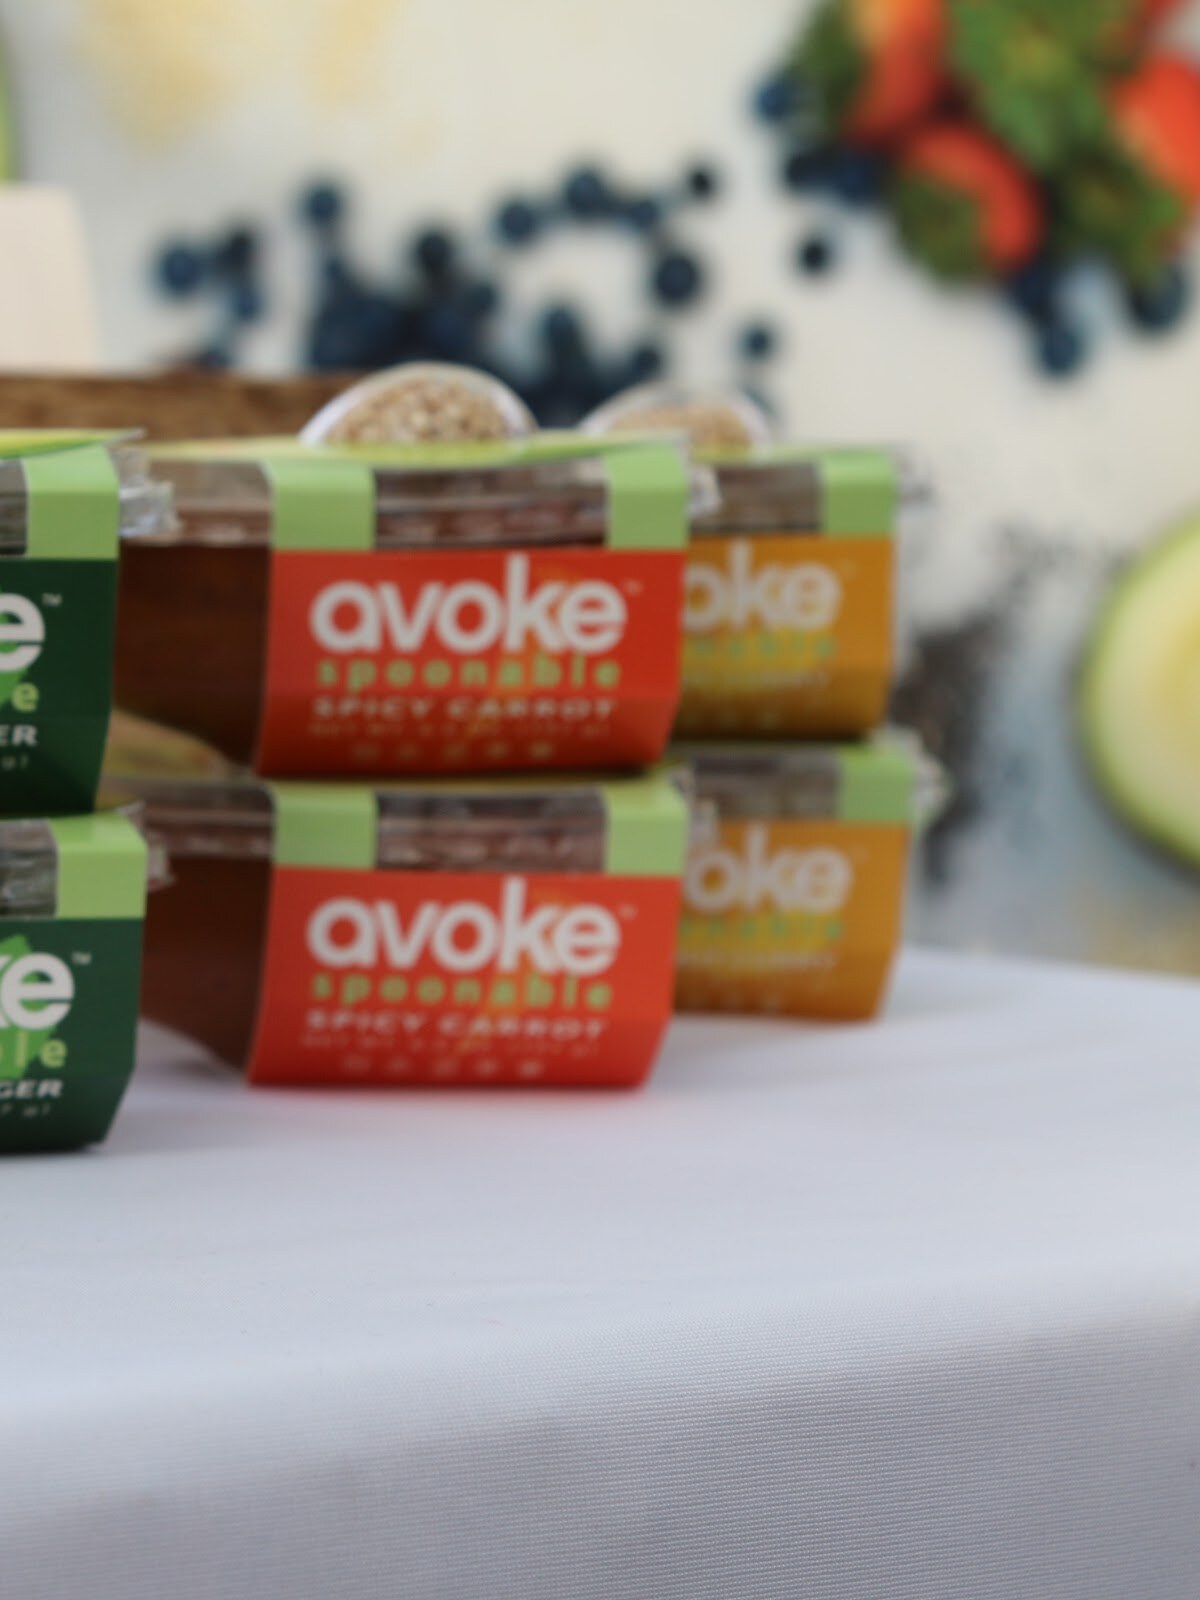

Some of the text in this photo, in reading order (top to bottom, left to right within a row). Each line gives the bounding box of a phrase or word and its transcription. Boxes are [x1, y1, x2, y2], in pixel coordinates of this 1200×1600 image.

[309, 553, 628, 653] avoke
[680, 538, 842, 631] oke
[318, 653, 621, 691] spoonable
[686, 823, 852, 915] oke
[307, 876, 621, 975] avoke
[313, 973, 613, 1013] spoonable
